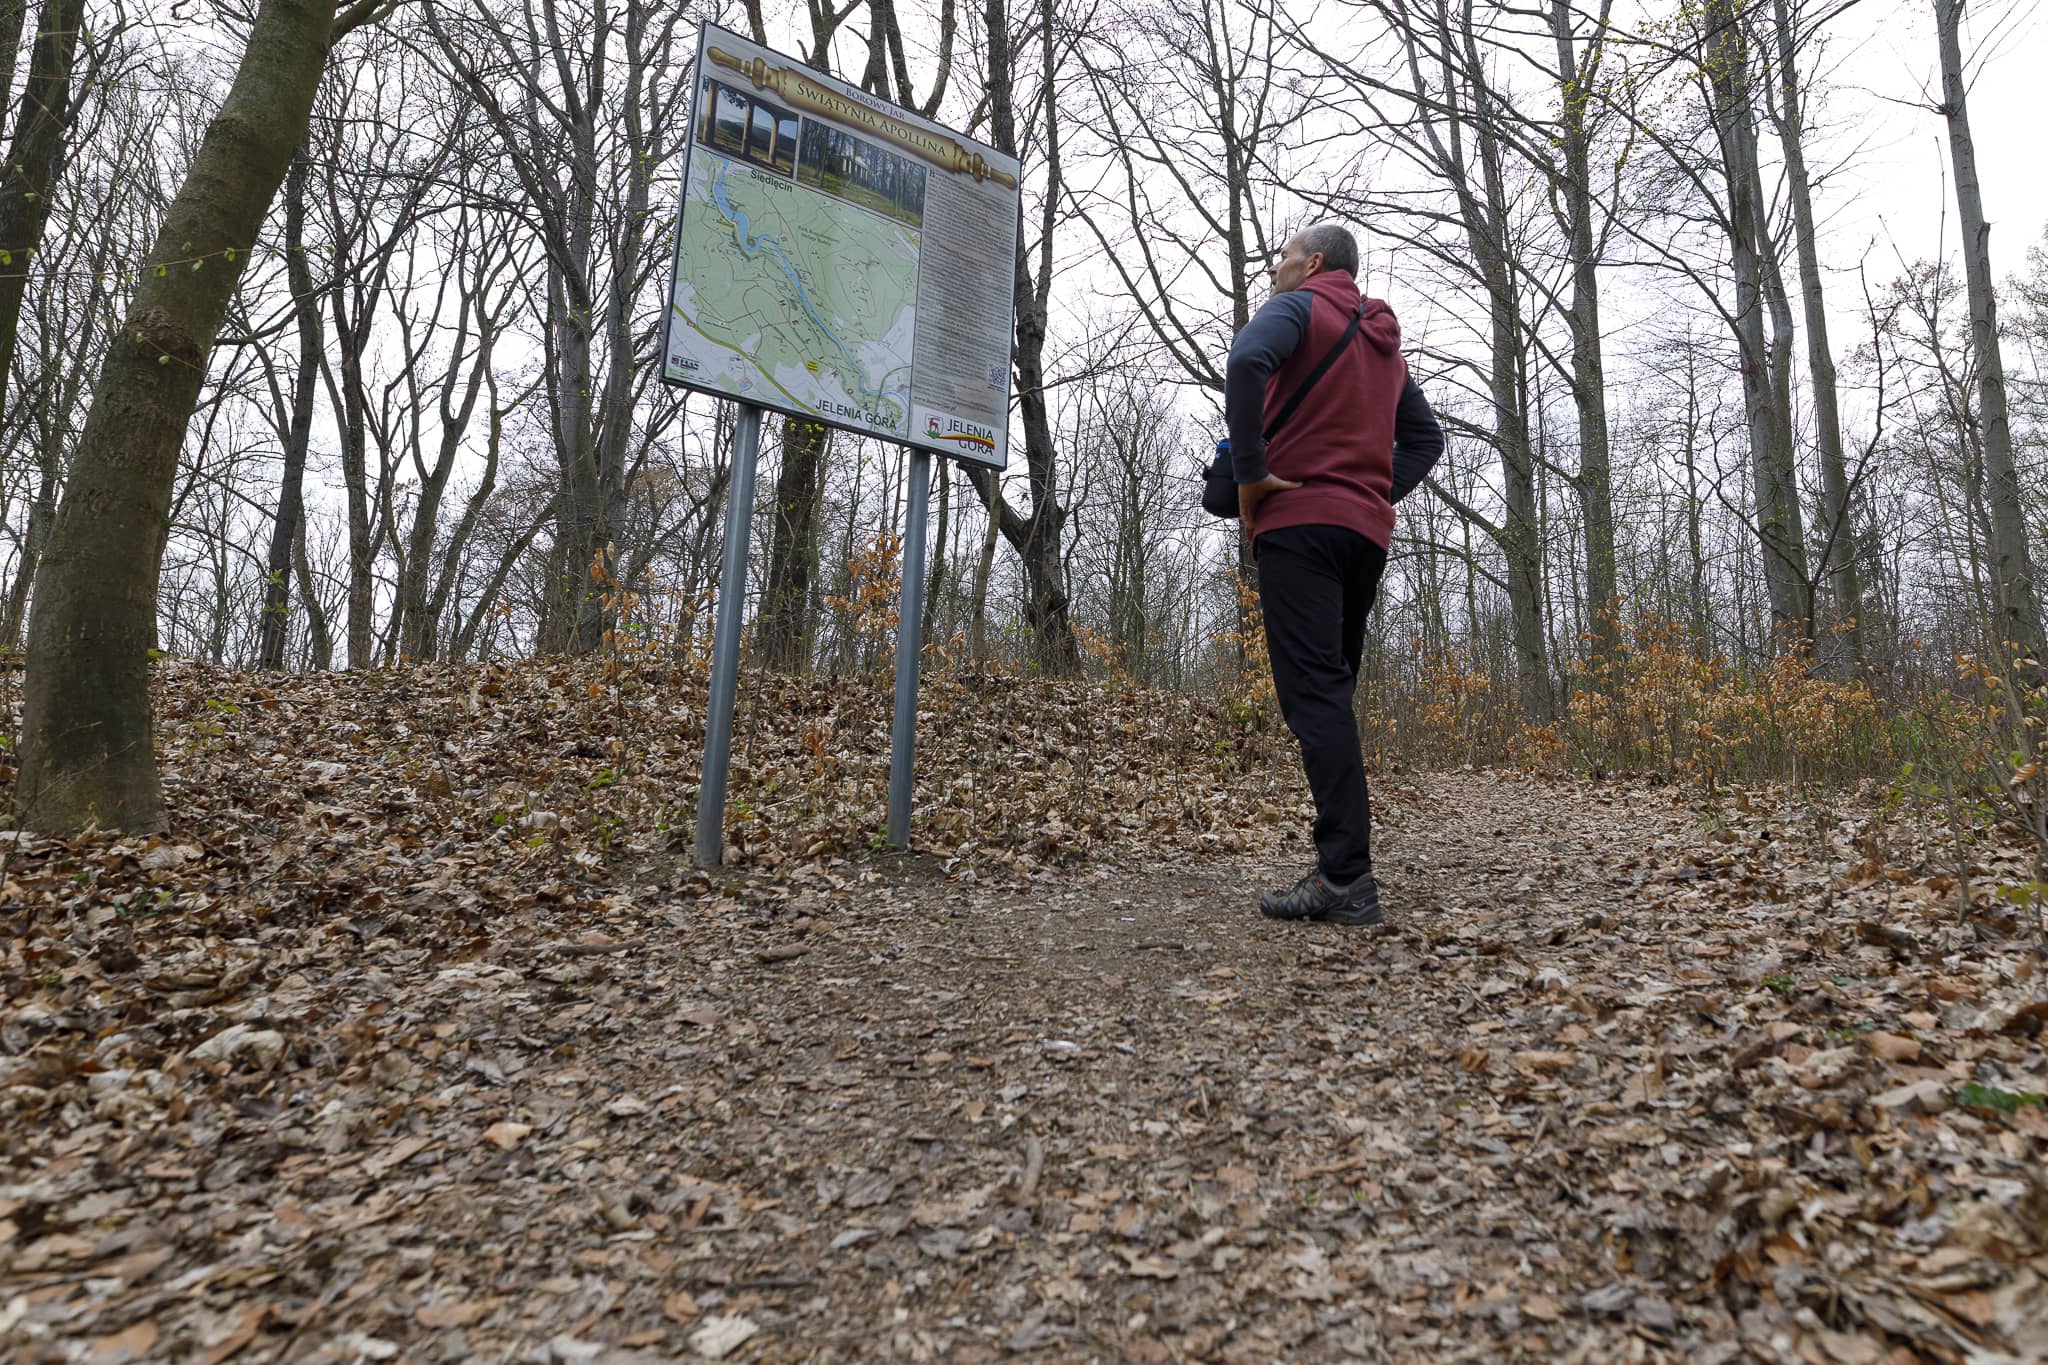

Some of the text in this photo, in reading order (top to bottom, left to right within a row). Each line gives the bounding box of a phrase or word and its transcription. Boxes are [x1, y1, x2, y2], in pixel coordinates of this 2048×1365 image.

[796, 81, 946, 157] ŚWIĄTYNIA APOLLINA
[846, 87, 906, 120] BOROWY JAR
[750, 168, 794, 193] Siedlęcin
[815, 399, 897, 431] JELENIA GÓRA
[946, 418, 994, 442] JELENIA
